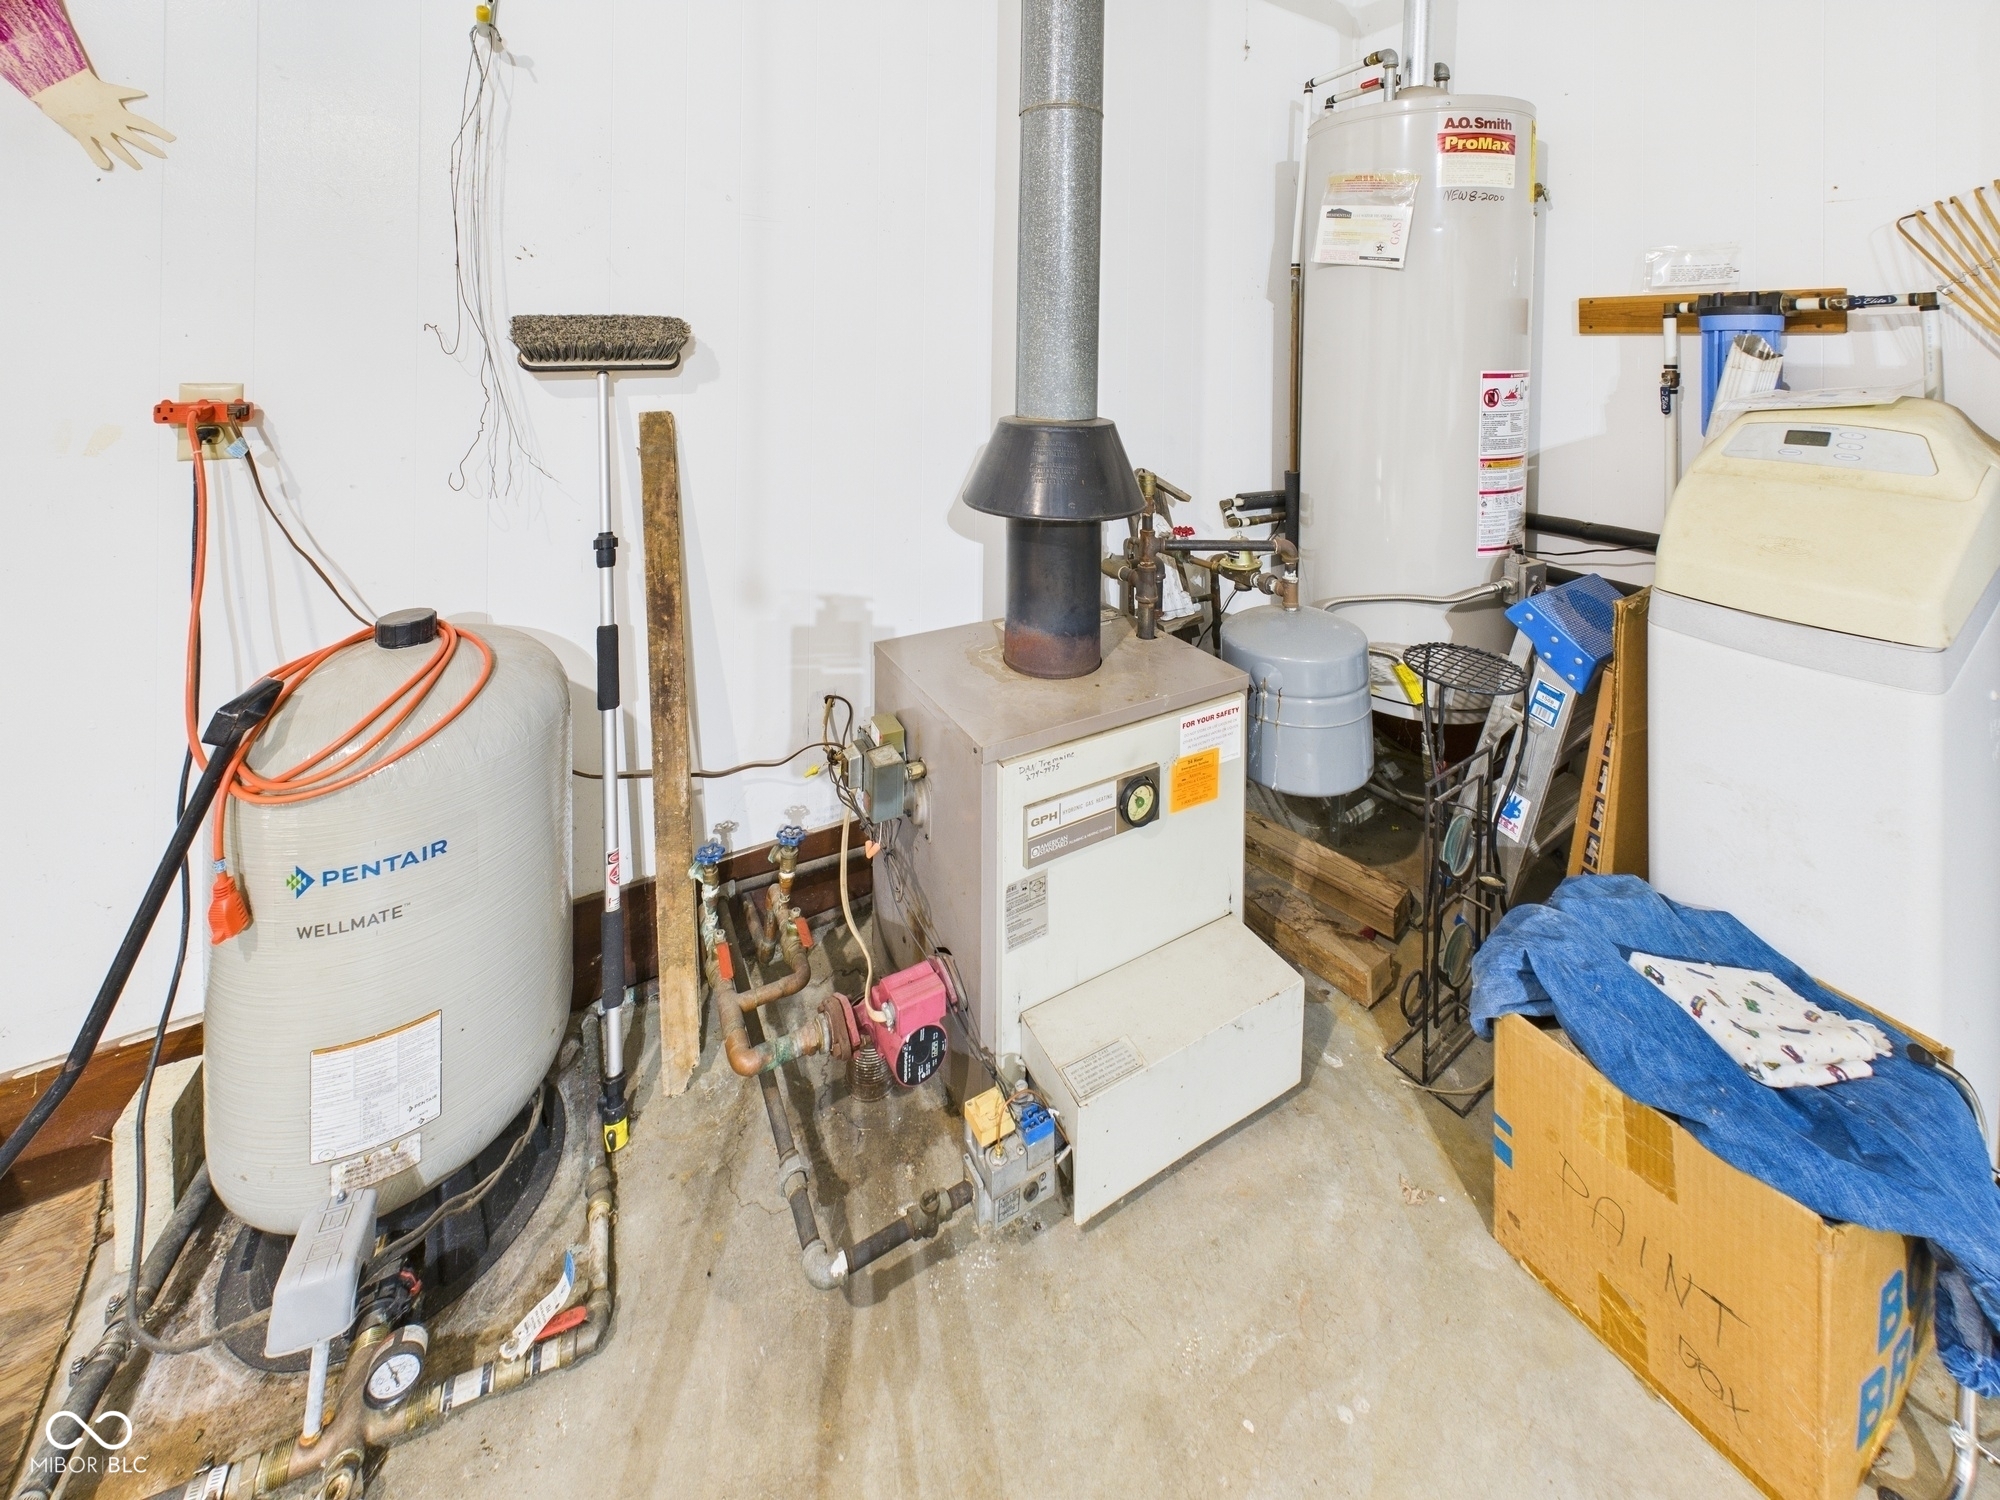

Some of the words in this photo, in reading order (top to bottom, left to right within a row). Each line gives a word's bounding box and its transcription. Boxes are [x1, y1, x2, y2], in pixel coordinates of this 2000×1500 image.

[1444, 116, 1474, 130] A.O.
[1474, 116, 1512, 131] Smith
[1444, 136, 1510, 151] ProMax
[1390, 222, 1402, 246] GAS
[1182, 719, 1196, 730] FOR
[1196, 714, 1215, 727] YOUR
[1216, 706, 1240, 720] SAFETY
[1084, 799, 1095, 809] GAS
[1095, 792, 1113, 805] HEATING
[1030, 810, 1058, 828] GPH
[1038, 834, 1068, 850] AMERICAN
[322, 838, 448, 888] PENTAIR
[1556, 1150, 1751, 1348] PAINT
[1678, 1333, 1750, 1434] BOX
